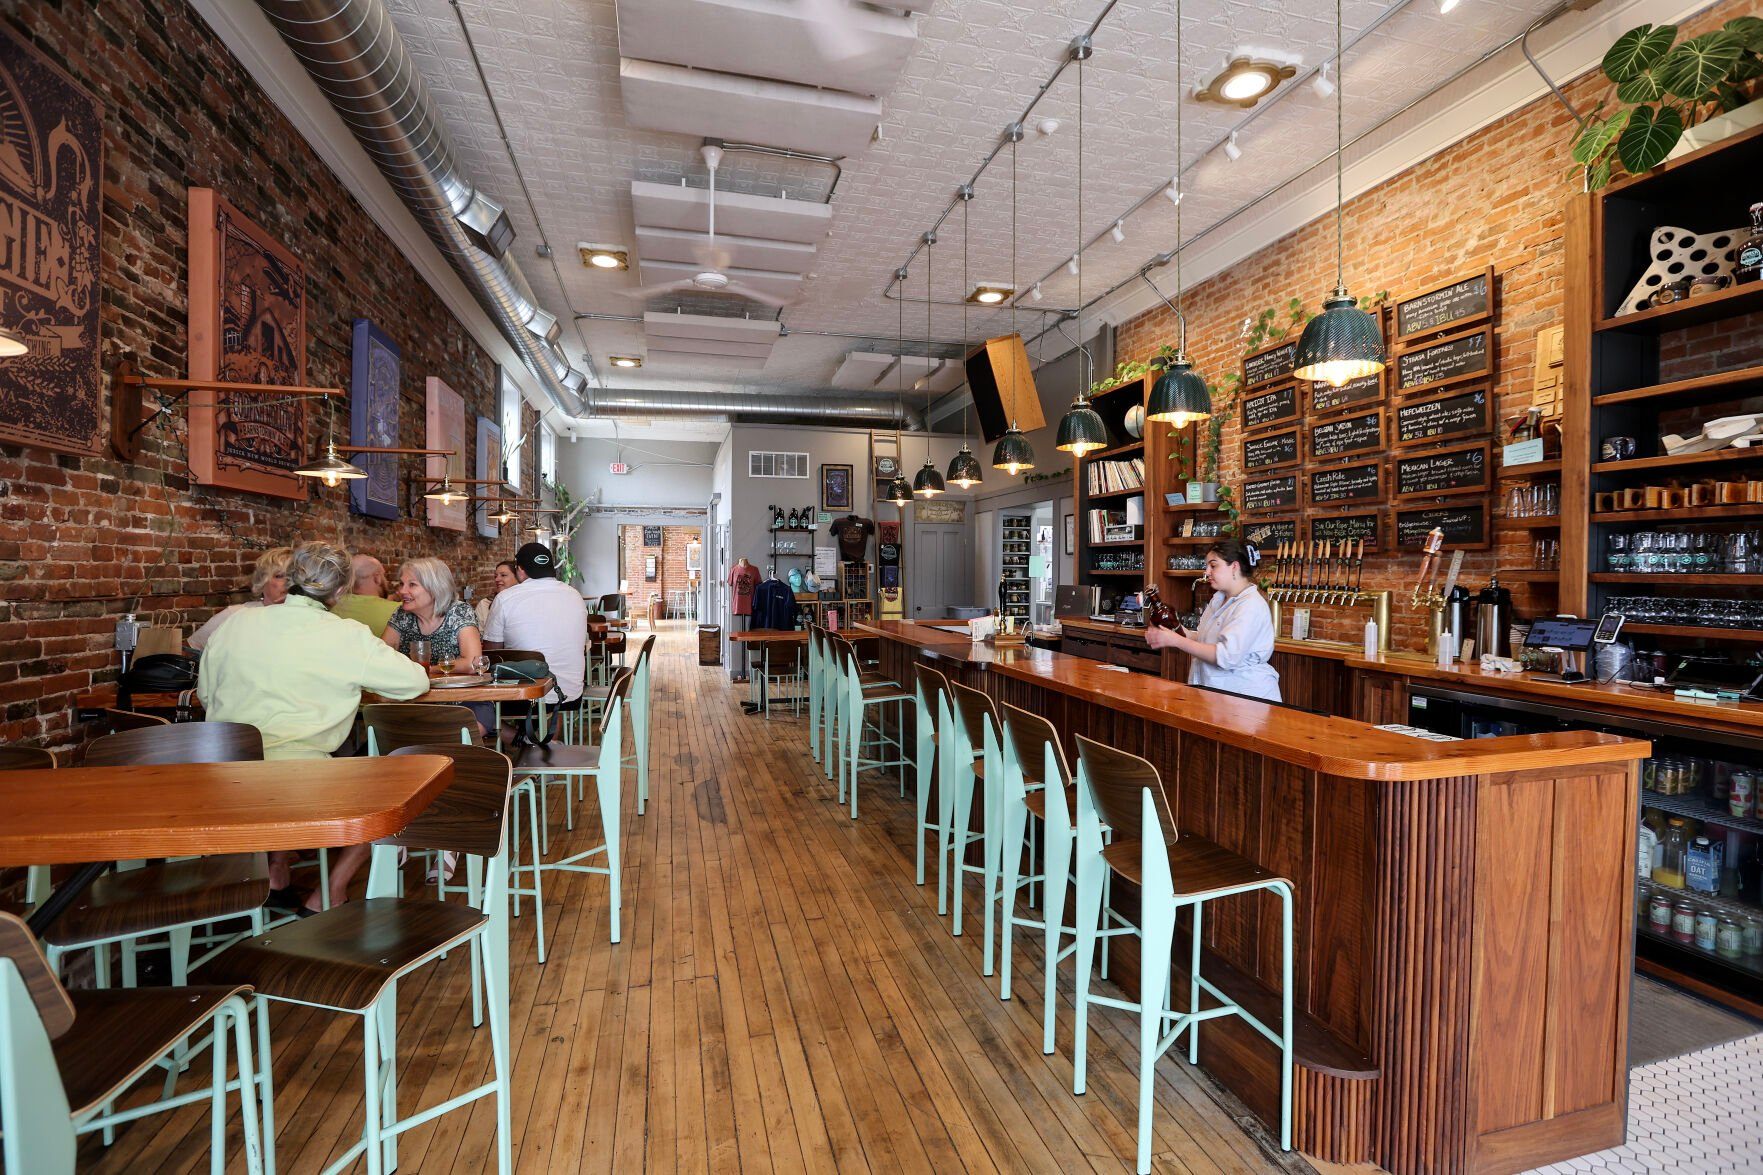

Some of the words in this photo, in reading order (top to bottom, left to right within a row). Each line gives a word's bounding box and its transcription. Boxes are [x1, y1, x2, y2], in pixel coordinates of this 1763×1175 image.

[1456, 283, 1469, 293] ALE
[1473, 281, 1487, 295] $6
[1406, 322, 1421, 333] ABV
[1435, 312, 1453, 324] IBU
[1469, 336, 1482, 347] $7
[1403, 380, 1415, 388] ABV
[1424, 375, 1434, 384] IBU
[1266, 395, 1276, 403] IPA
[1366, 416, 1377, 424] $6
[1401, 464, 1428, 473] MEXICAN
[1431, 459, 1454, 467] LAGER
[1466, 452, 1482, 462] $6
[613, 464, 624, 472] EXIT
[1326, 521, 1336, 529] Our
[1691, 866, 1705, 875] OAT
